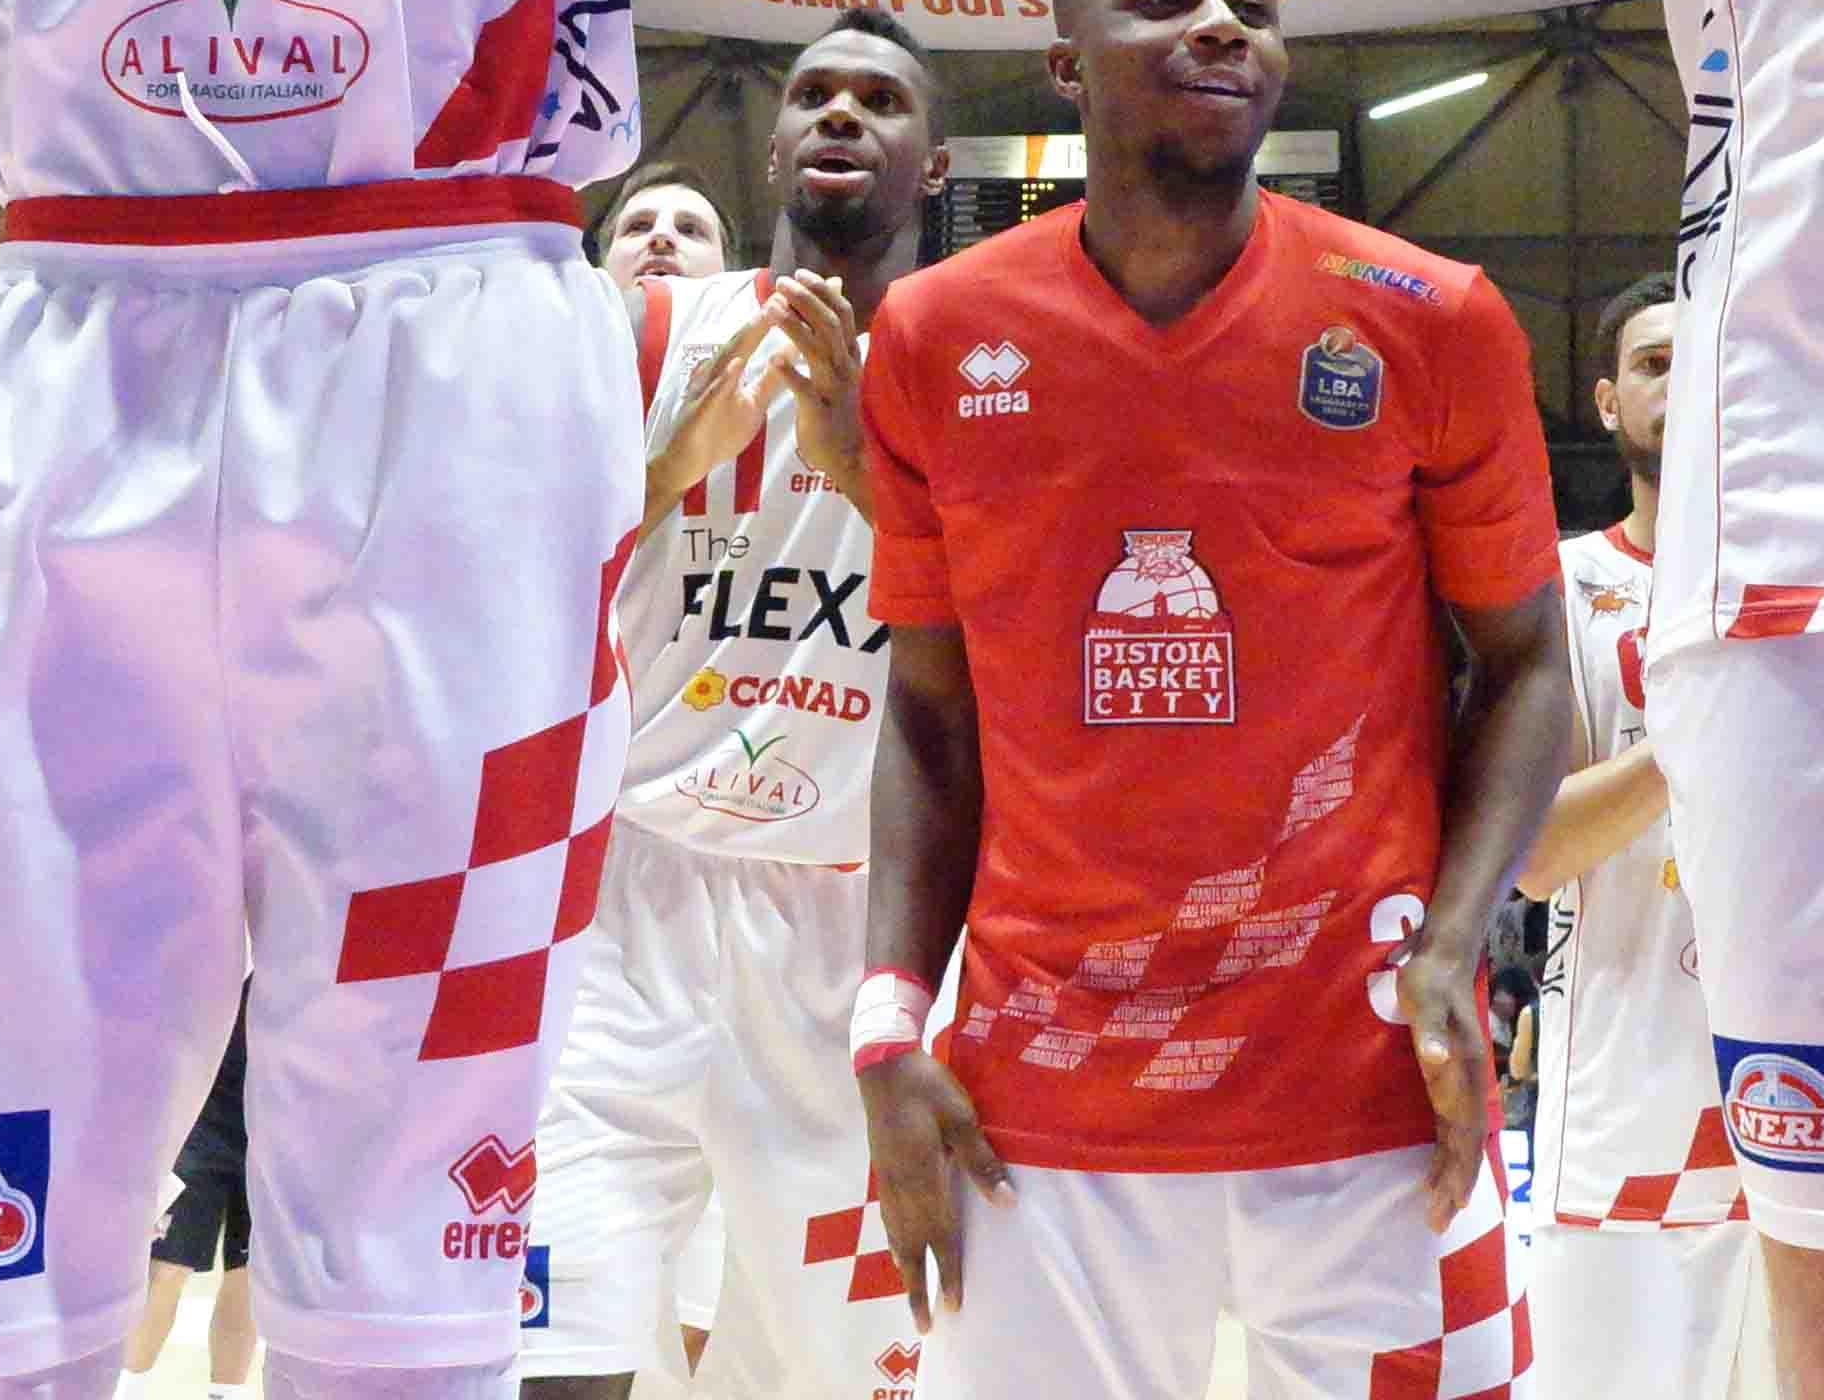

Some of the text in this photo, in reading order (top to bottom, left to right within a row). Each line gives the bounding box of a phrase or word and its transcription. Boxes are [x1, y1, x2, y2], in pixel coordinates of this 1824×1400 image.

[121, 36, 347, 77] ALIVAL
[147, 81, 324, 100] FORMAGGI ITALIANI
[1318, 378, 1364, 398] LBA
[958, 389, 1030, 418] errea
[682, 528, 751, 561] The
[1095, 641, 1223, 665] PISTOIA
[1095, 666, 1224, 690] BASKET
[728, 673, 870, 723] CONAD
[1094, 691, 1223, 715] CITY
[683, 766, 804, 807] ALIVAL
